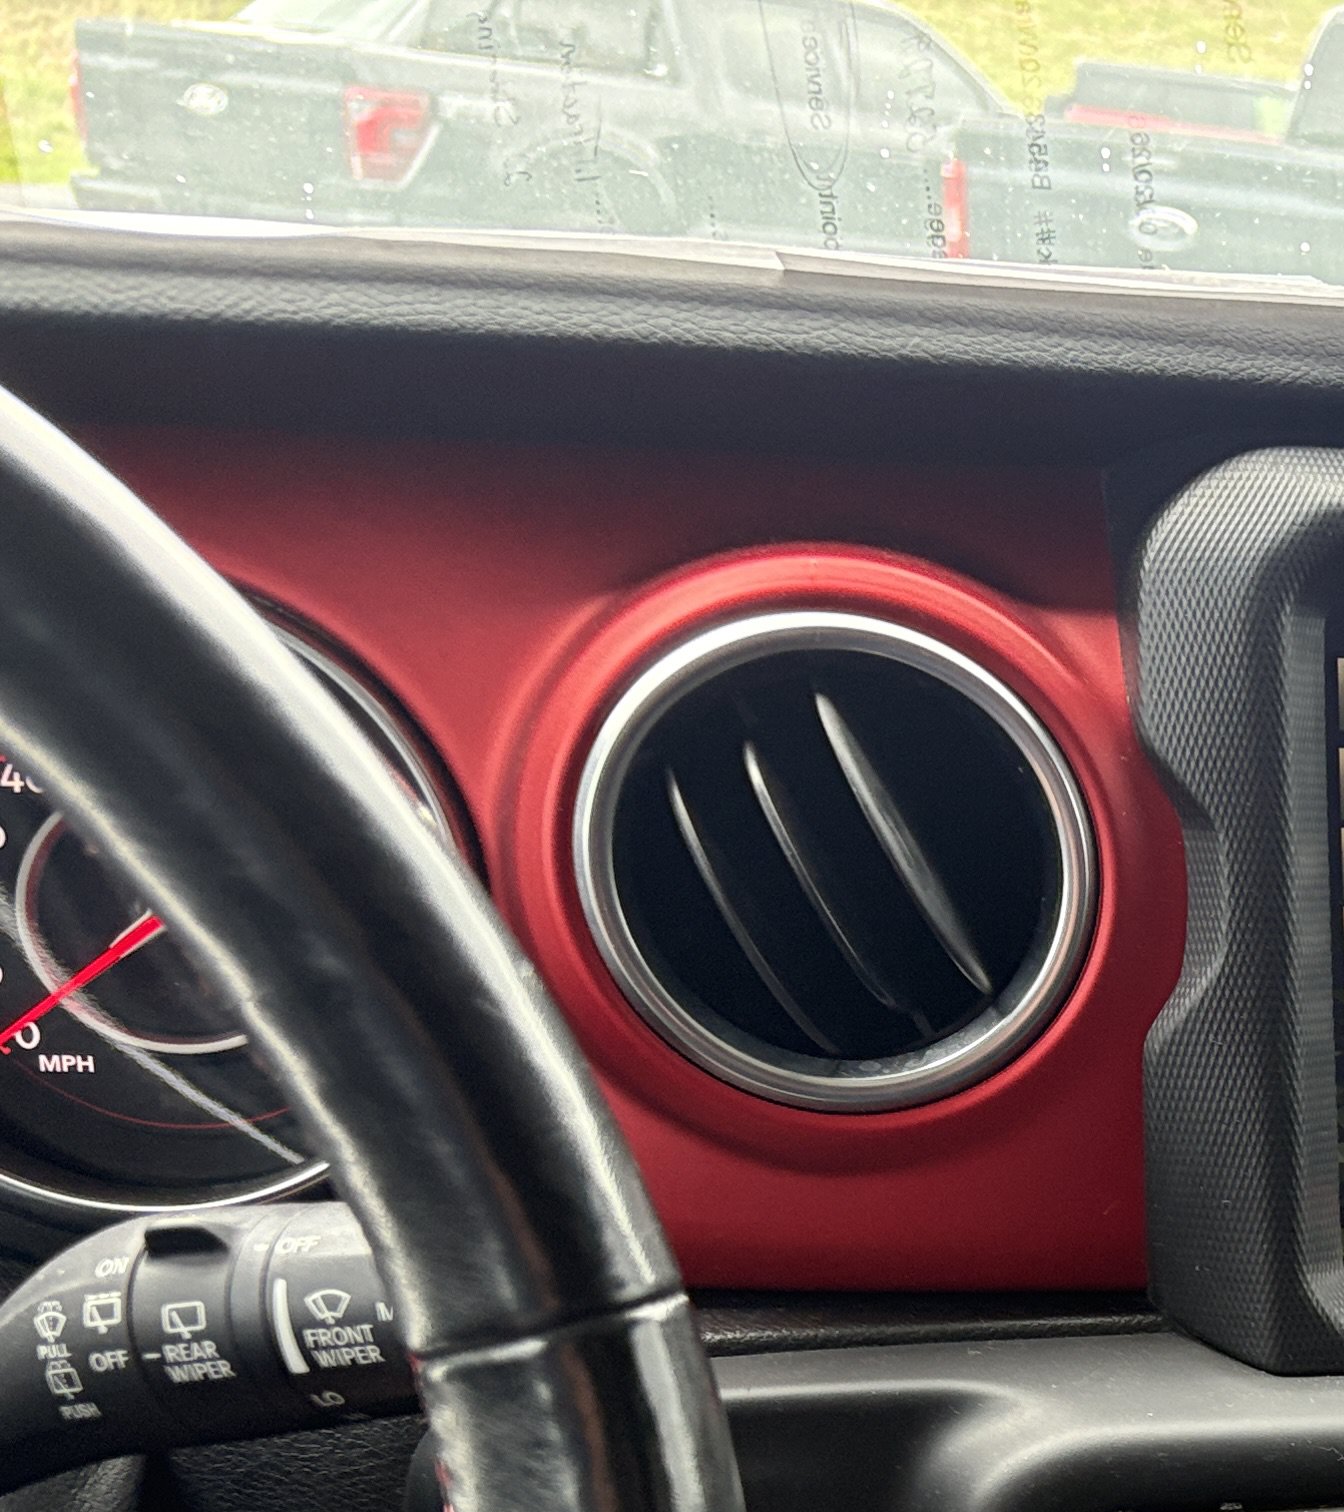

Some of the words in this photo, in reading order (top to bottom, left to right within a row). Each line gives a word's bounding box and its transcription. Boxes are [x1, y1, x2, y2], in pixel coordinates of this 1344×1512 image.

[38, 1053, 95, 1074] MPH
[275, 1236, 320, 1254] OFF
[95, 1257, 129, 1278] ON
[303, 1324, 374, 1348] FRONT
[37, 1343, 72, 1360] PULL
[89, 1349, 131, 1372] OFF
[161, 1340, 220, 1363] REAR
[311, 1346, 385, 1368] WIPER
[163, 1360, 236, 1384] WIPER
[59, 1403, 101, 1421] PUSH
